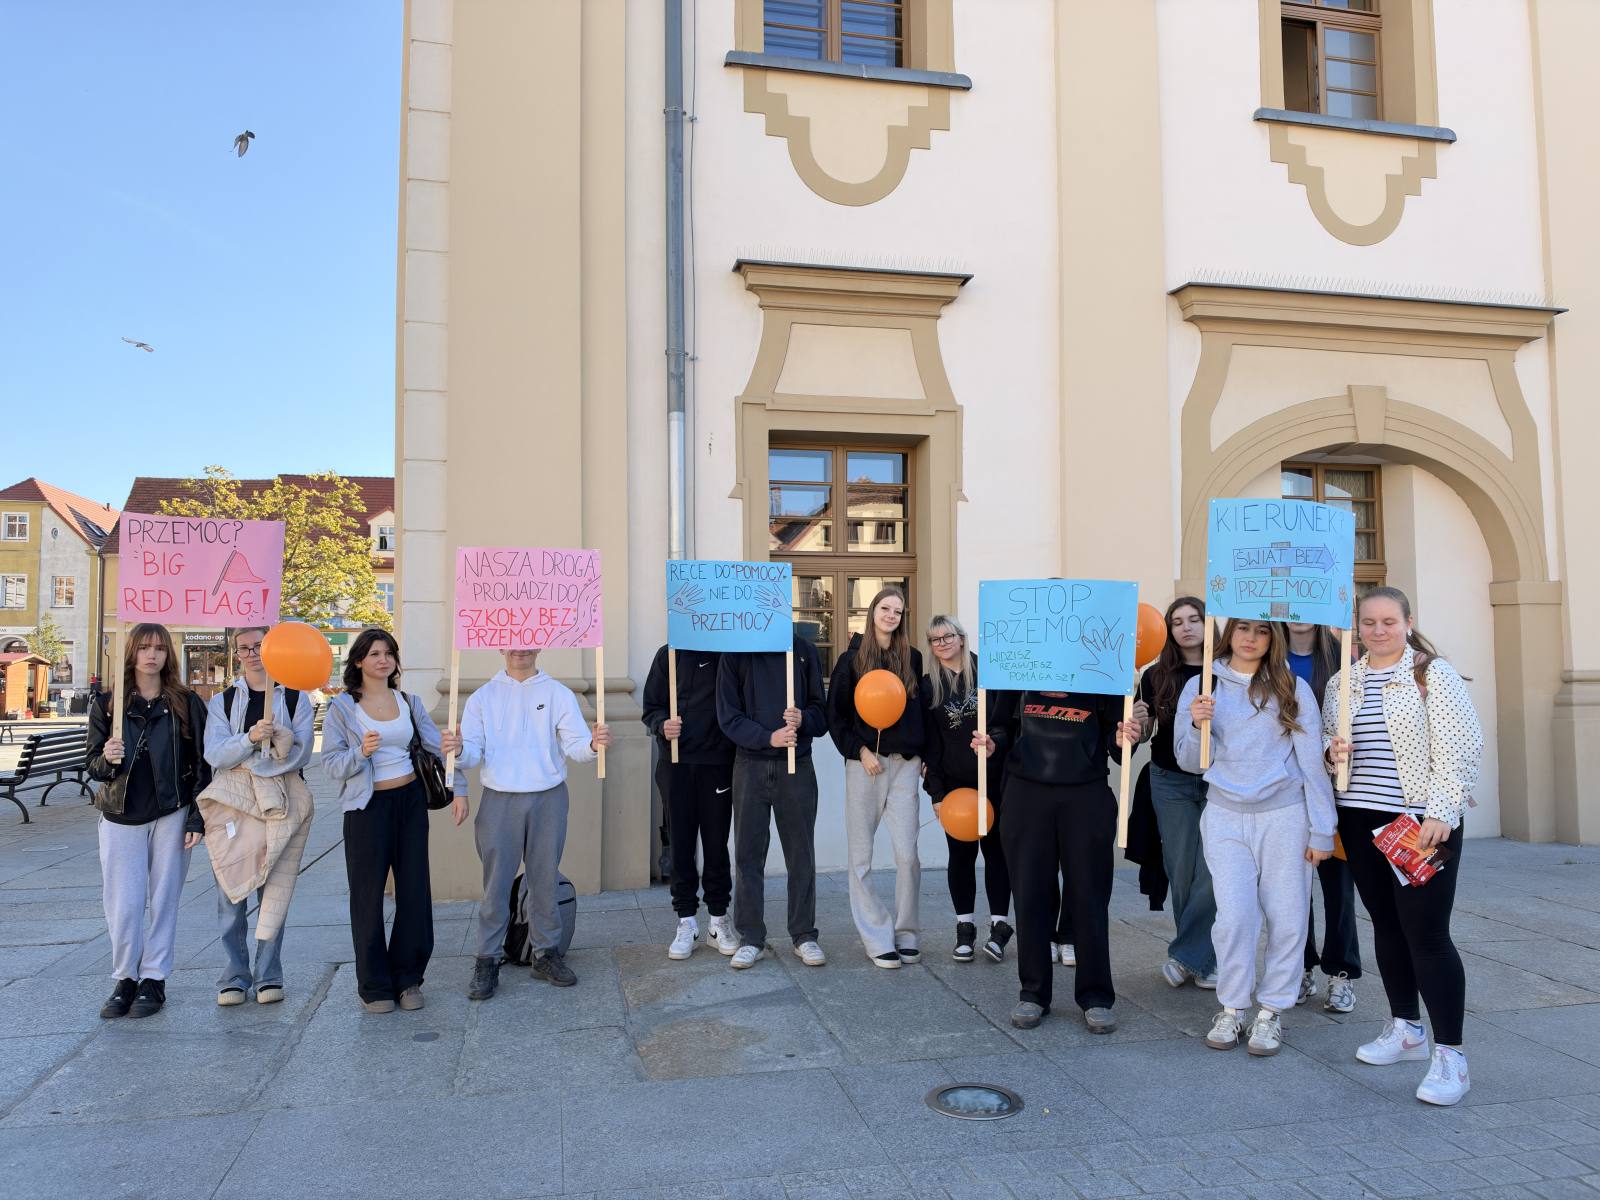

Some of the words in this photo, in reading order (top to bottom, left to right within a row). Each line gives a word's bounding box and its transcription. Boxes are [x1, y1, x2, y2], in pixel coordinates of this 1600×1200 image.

[128, 519, 244, 548] PRZEMOC?
[143, 551, 185, 576] BIG
[464, 551, 534, 579] NASZA
[542, 551, 597, 578] DROGA
[1296, 549, 1325, 564] BEZ
[714, 563, 731, 579] DO
[473, 581, 554, 602] PROWADZI
[557, 584, 579, 603] DO
[734, 585, 753, 600] DO
[1009, 584, 1091, 615] STOP
[1238, 579, 1329, 600] PRZEMOCY
[123, 588, 173, 613] RED
[458, 607, 533, 628] SZKOŁY
[539, 607, 573, 627] BEZ
[691, 612, 774, 632] PRZEMOCY
[467, 628, 555, 648] PRZEMOCY
[983, 614, 1121, 646] PRZEMOCY
[989, 649, 1032, 664] WIDZISZ
[1000, 660, 1053, 671] REAGUJESZ
